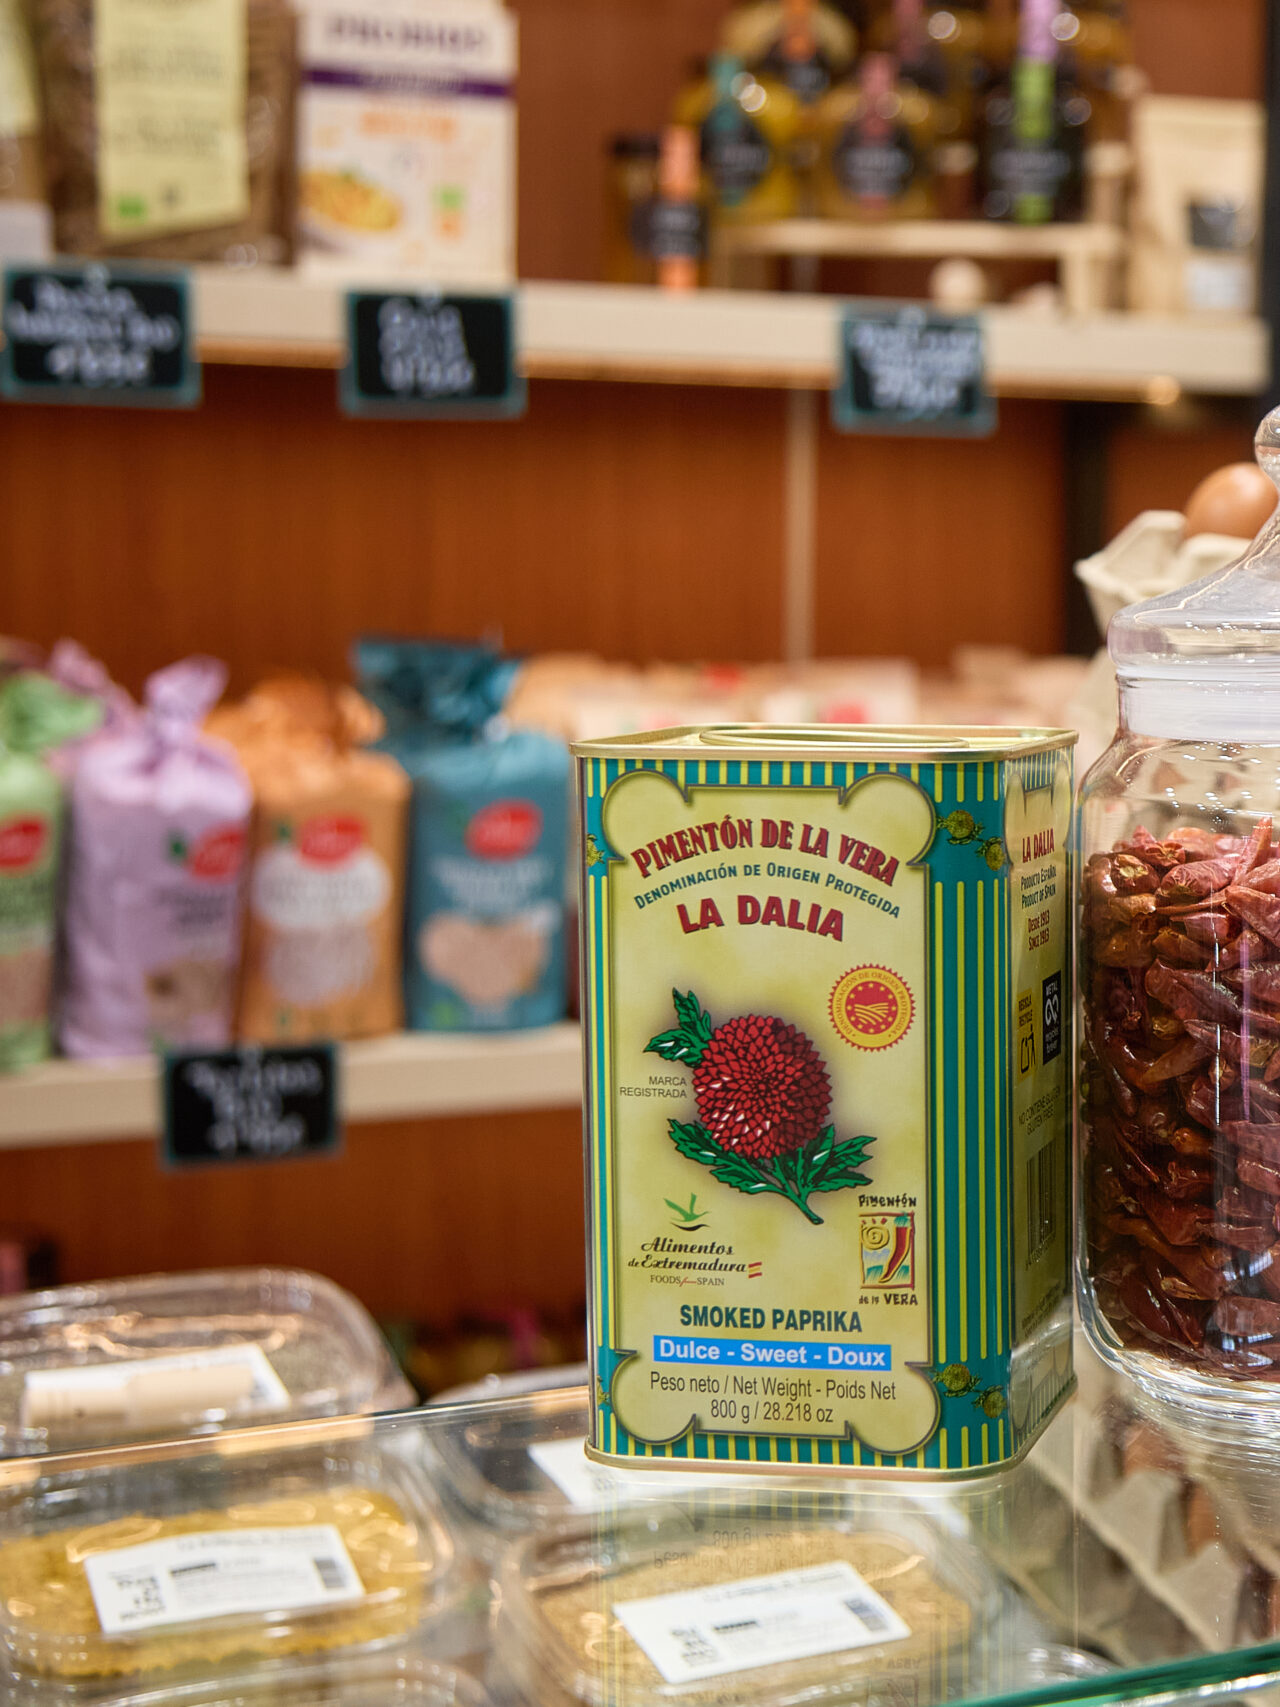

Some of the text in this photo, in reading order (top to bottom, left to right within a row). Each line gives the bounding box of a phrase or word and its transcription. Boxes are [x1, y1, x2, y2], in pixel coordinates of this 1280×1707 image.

[630, 814, 900, 887] PIMENTÓN DE LA VERA
[1022, 828, 1055, 863] LA DALIA
[634, 862, 900, 918] DENOMINACIÓN DE ORIGEN PROTEGIDA
[676, 895, 844, 942] LA DALIA
[619, 1086, 687, 1098] REGISTRADA
[648, 1075, 687, 1086] MARCA
[641, 1236, 734, 1255] Alimentos
[641, 1254, 747, 1273] Extremadura
[650, 1274, 681, 1285] FOODS
[696, 1277, 725, 1286] SPAIN
[884, 1293, 918, 1306] VERA
[680, 1304, 863, 1333] SMOKED PAPRIKA
[660, 1338, 720, 1360] Dulce
[740, 1342, 808, 1364] Sweet
[827, 1346, 886, 1366] Doux
[650, 1371, 685, 1392] Peso
[689, 1375, 720, 1394] neto
[733, 1375, 758, 1396] Net
[761, 1376, 812, 1402] Weight
[826, 1379, 866, 1400] Poids
[871, 1380, 896, 1401] Net
[711, 1399, 737, 1419] 800
[741, 1404, 750, 1424] g
[763, 1401, 812, 1422] 28.218
[816, 1408, 834, 1423] oz
